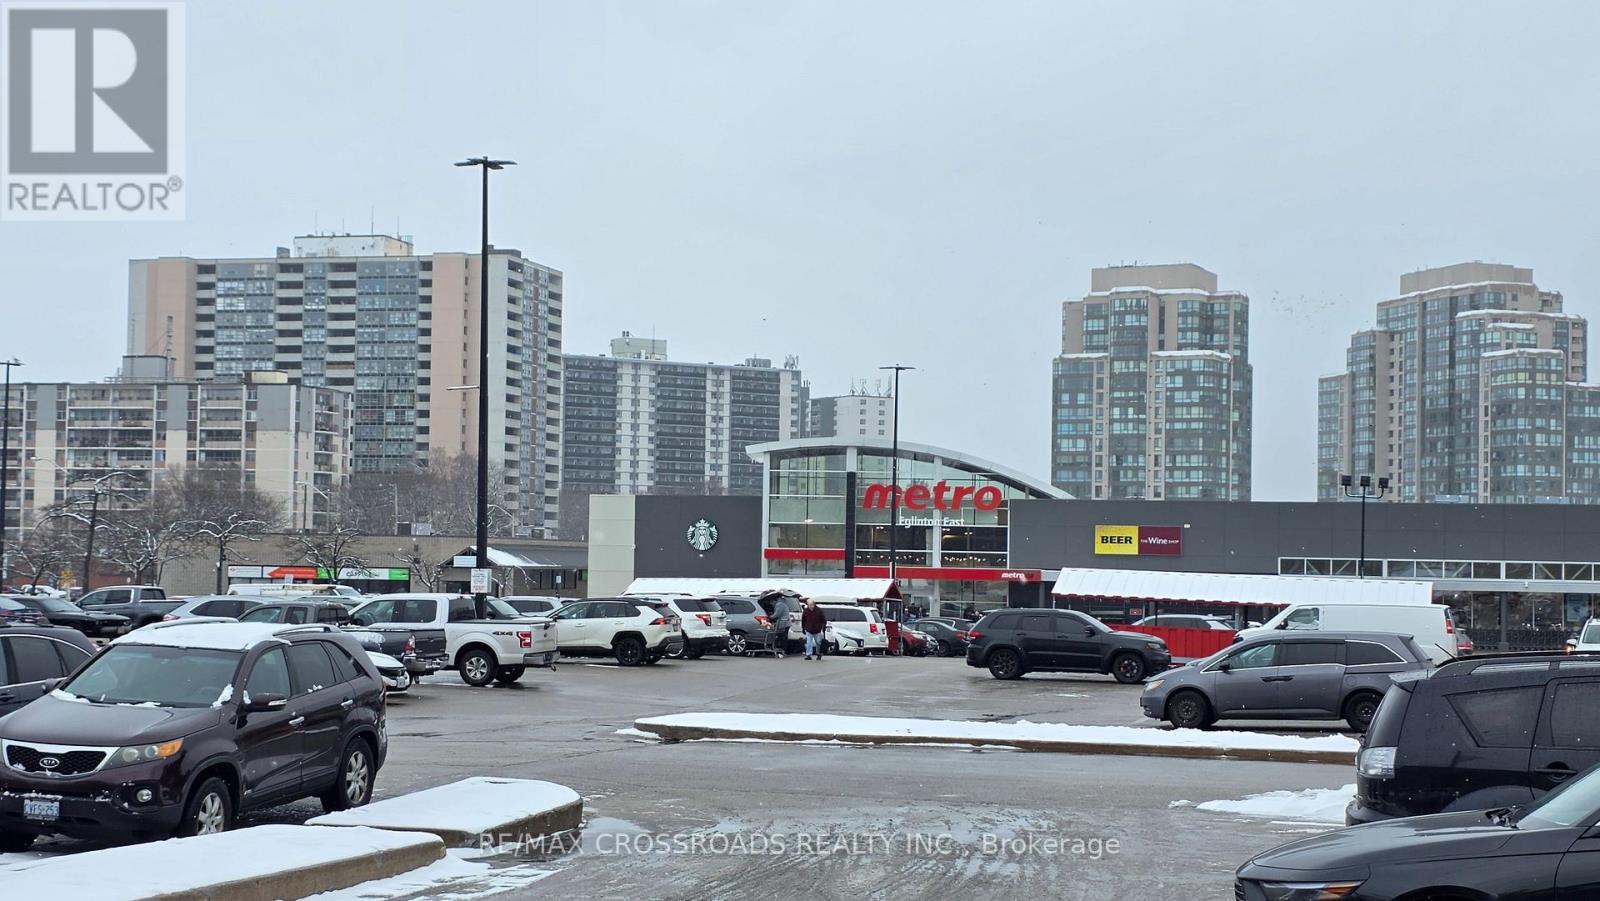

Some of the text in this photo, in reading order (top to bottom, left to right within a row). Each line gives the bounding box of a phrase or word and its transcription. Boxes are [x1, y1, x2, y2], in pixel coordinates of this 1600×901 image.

[862, 480, 1003, 512] metro
[899, 515, 965, 528] Eglinton East
[1101, 536, 1133, 544] BEER
[1148, 536, 1168, 545] Wine
